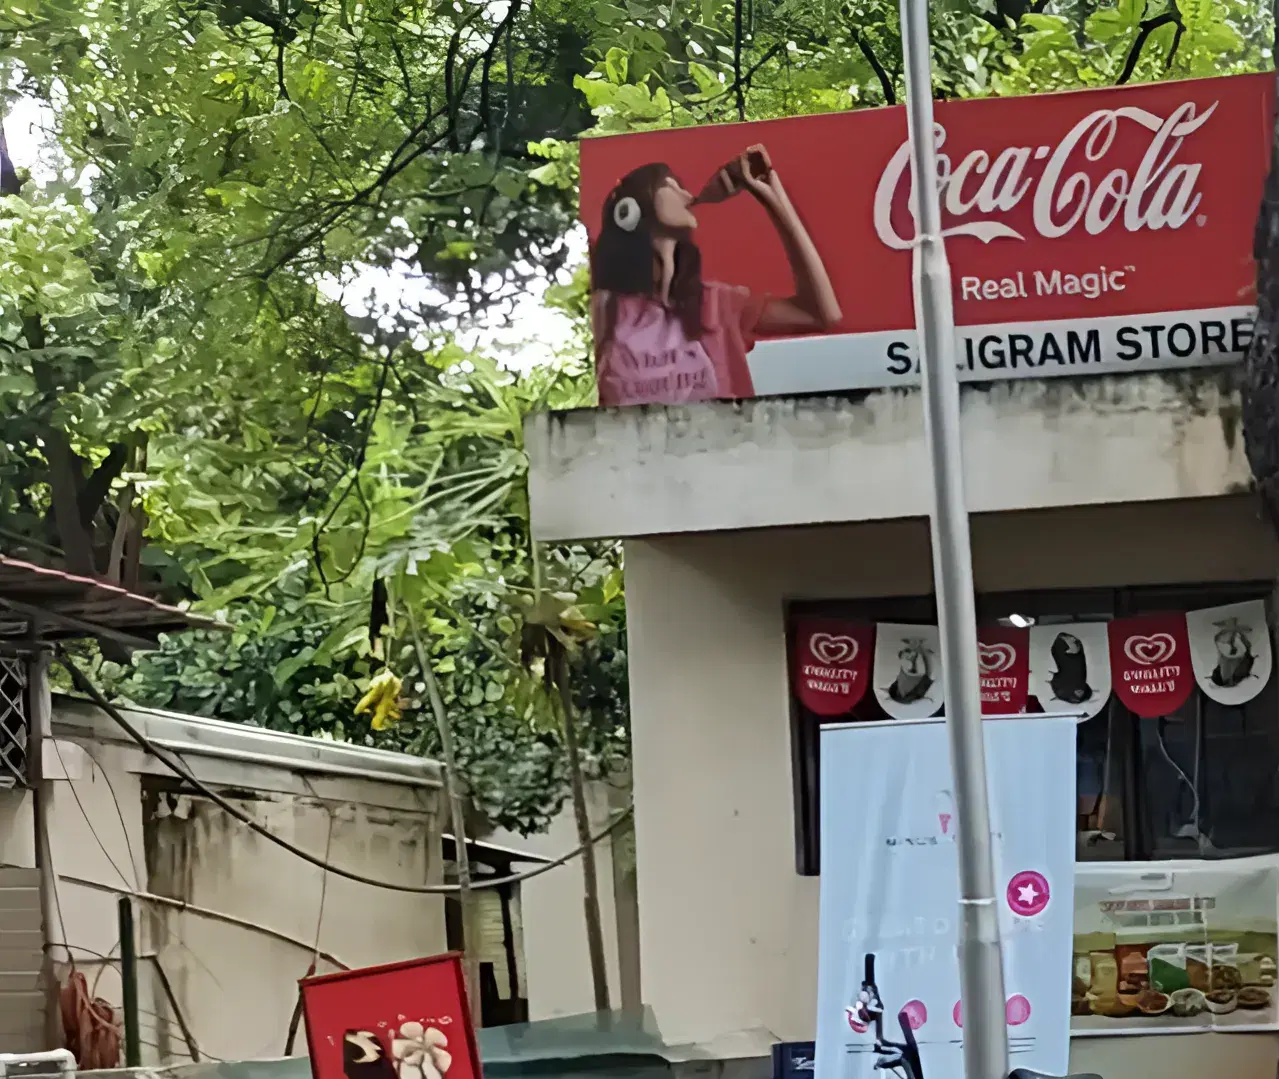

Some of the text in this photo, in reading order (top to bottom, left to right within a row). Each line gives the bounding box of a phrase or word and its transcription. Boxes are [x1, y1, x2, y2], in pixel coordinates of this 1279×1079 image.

[961, 271, 1028, 301] Real
[886, 317, 1255, 375] SIGRAM STORE
